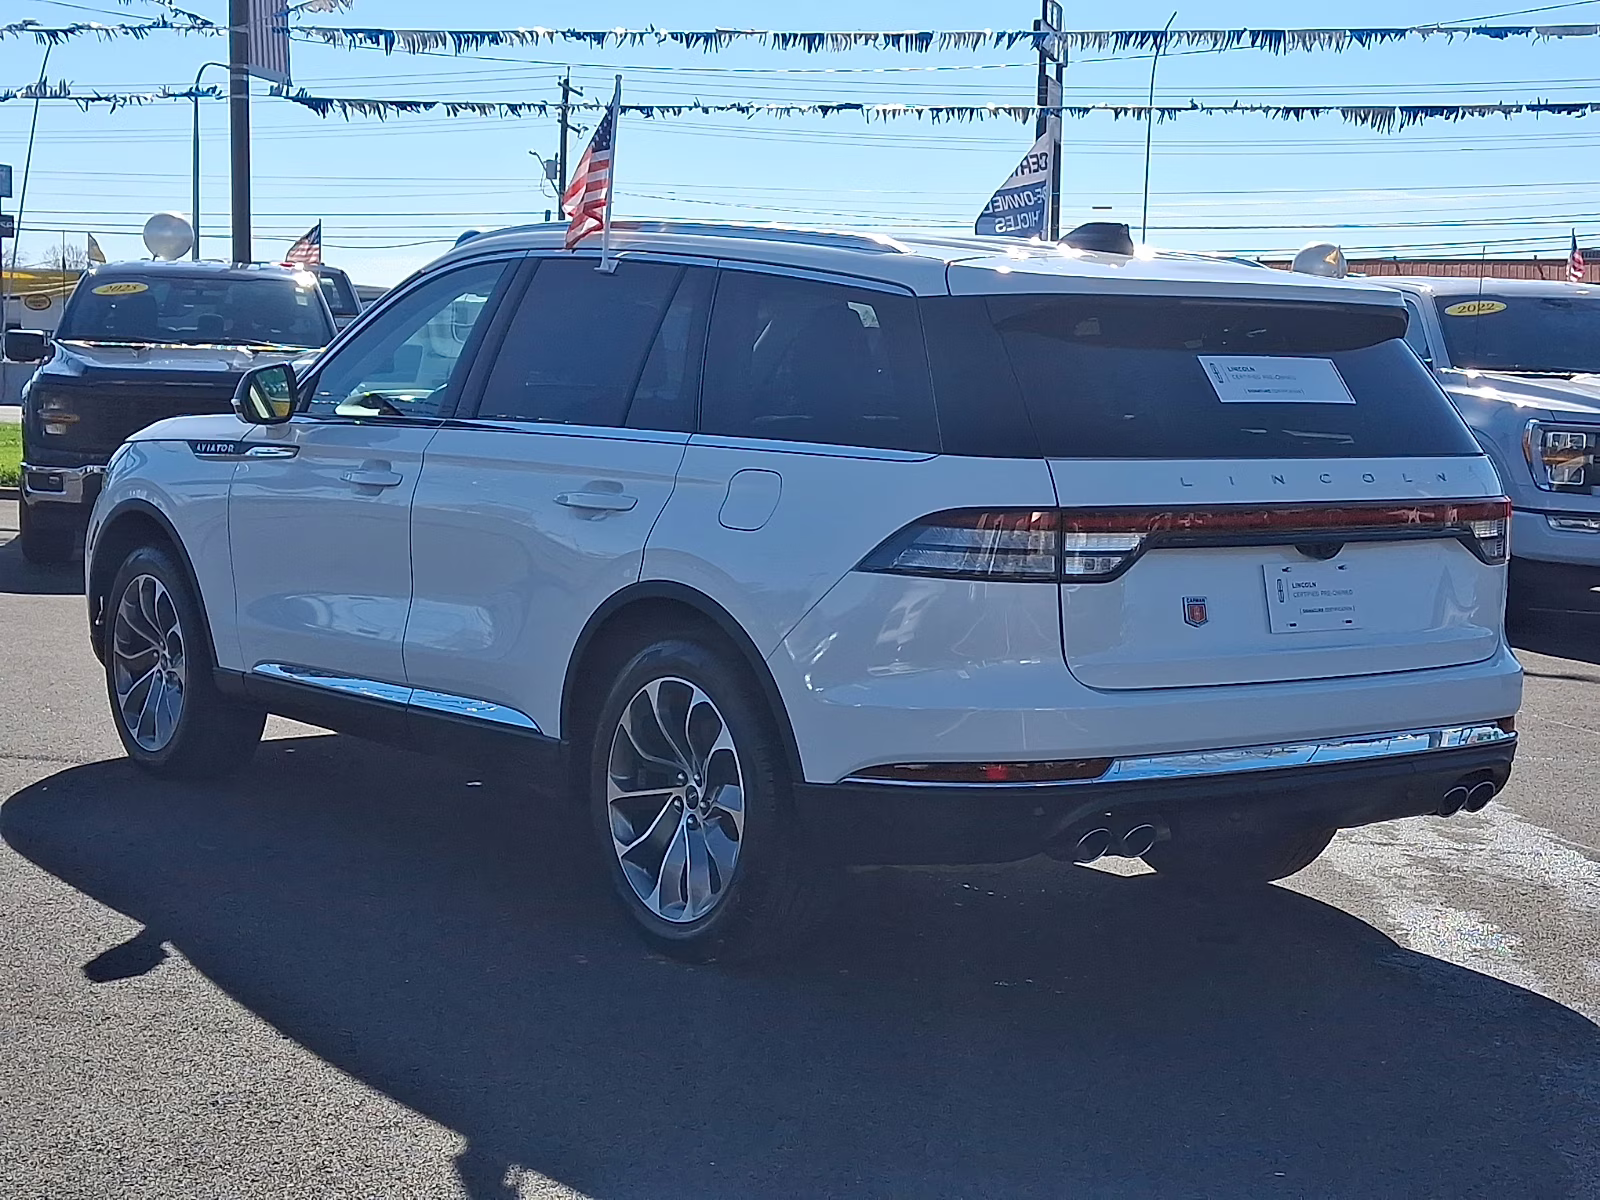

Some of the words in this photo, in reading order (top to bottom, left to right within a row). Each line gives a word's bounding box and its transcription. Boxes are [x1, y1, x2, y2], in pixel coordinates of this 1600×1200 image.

[1457, 302, 1495, 314] 2022
[196, 443, 235, 453] AVIATOR
[1180, 471, 1448, 487] LINCOLN
[1291, 581, 1317, 589] LINCOLN
